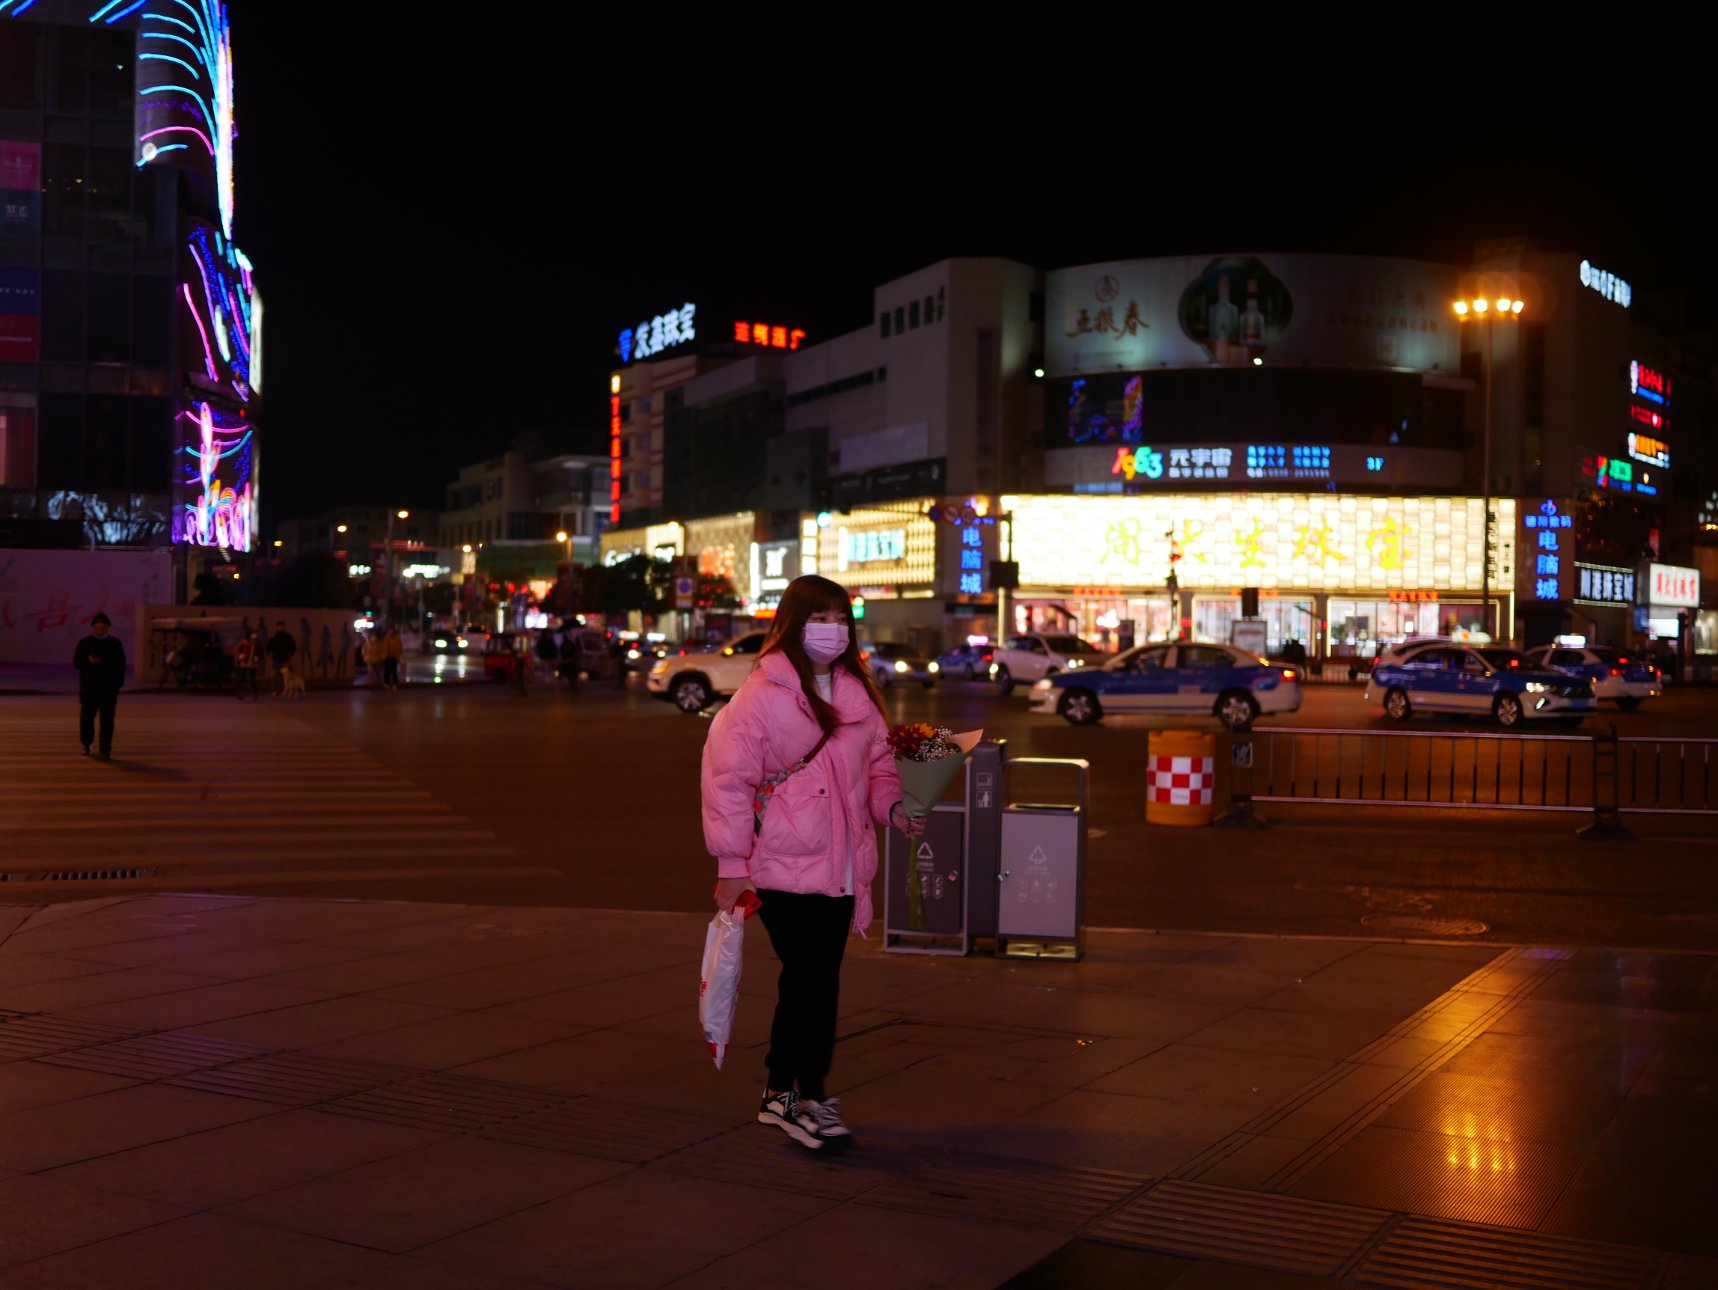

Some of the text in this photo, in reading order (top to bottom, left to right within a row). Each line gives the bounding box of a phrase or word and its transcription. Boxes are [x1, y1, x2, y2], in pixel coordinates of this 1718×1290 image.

[1112, 446, 1164, 480] 1963
[1169, 447, 1233, 466] 元宇宙
[959, 526, 983, 594] 电脑城
[1536, 529, 1560, 600] 电脑城
